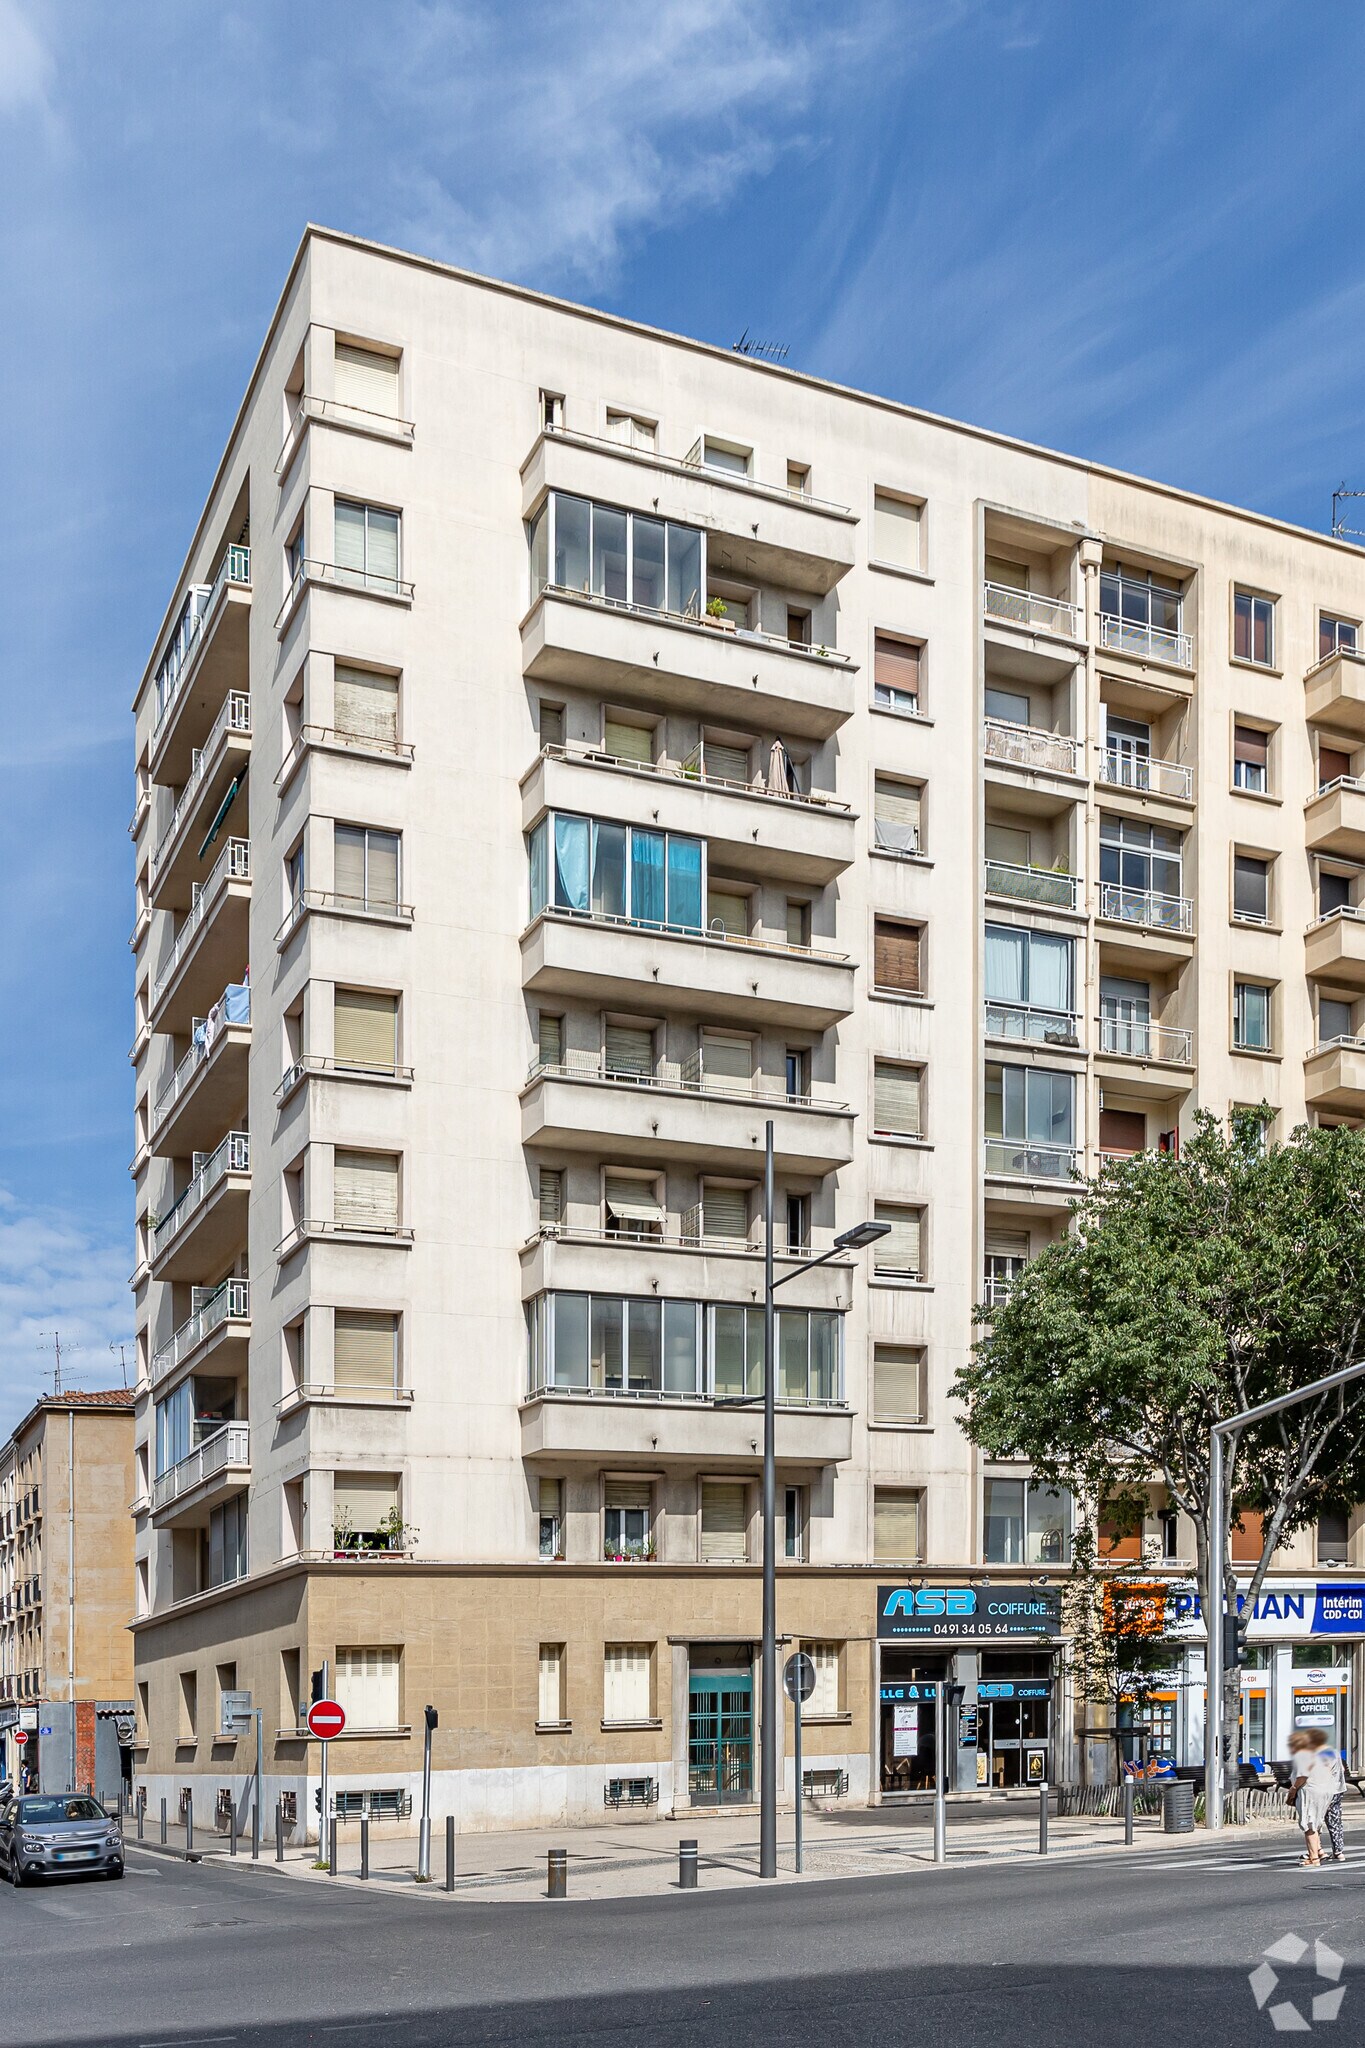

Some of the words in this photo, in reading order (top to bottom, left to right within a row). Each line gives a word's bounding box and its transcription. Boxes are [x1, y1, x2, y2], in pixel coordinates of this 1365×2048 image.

[883, 1589, 977, 1616] ASB
[1175, 1594, 1304, 1619] PMAN
[1323, 1596, 1363, 1609] Intérim
[1323, 1609, 1342, 1620] CDD
[1347, 1609, 1363, 1620] CDI
[961, 1624, 975, 1634] 34
[978, 1624, 992, 1634] 05
[995, 1624, 1009, 1634] 64
[908, 1685, 920, 1699] &
[977, 1683, 1014, 1698] ASB
